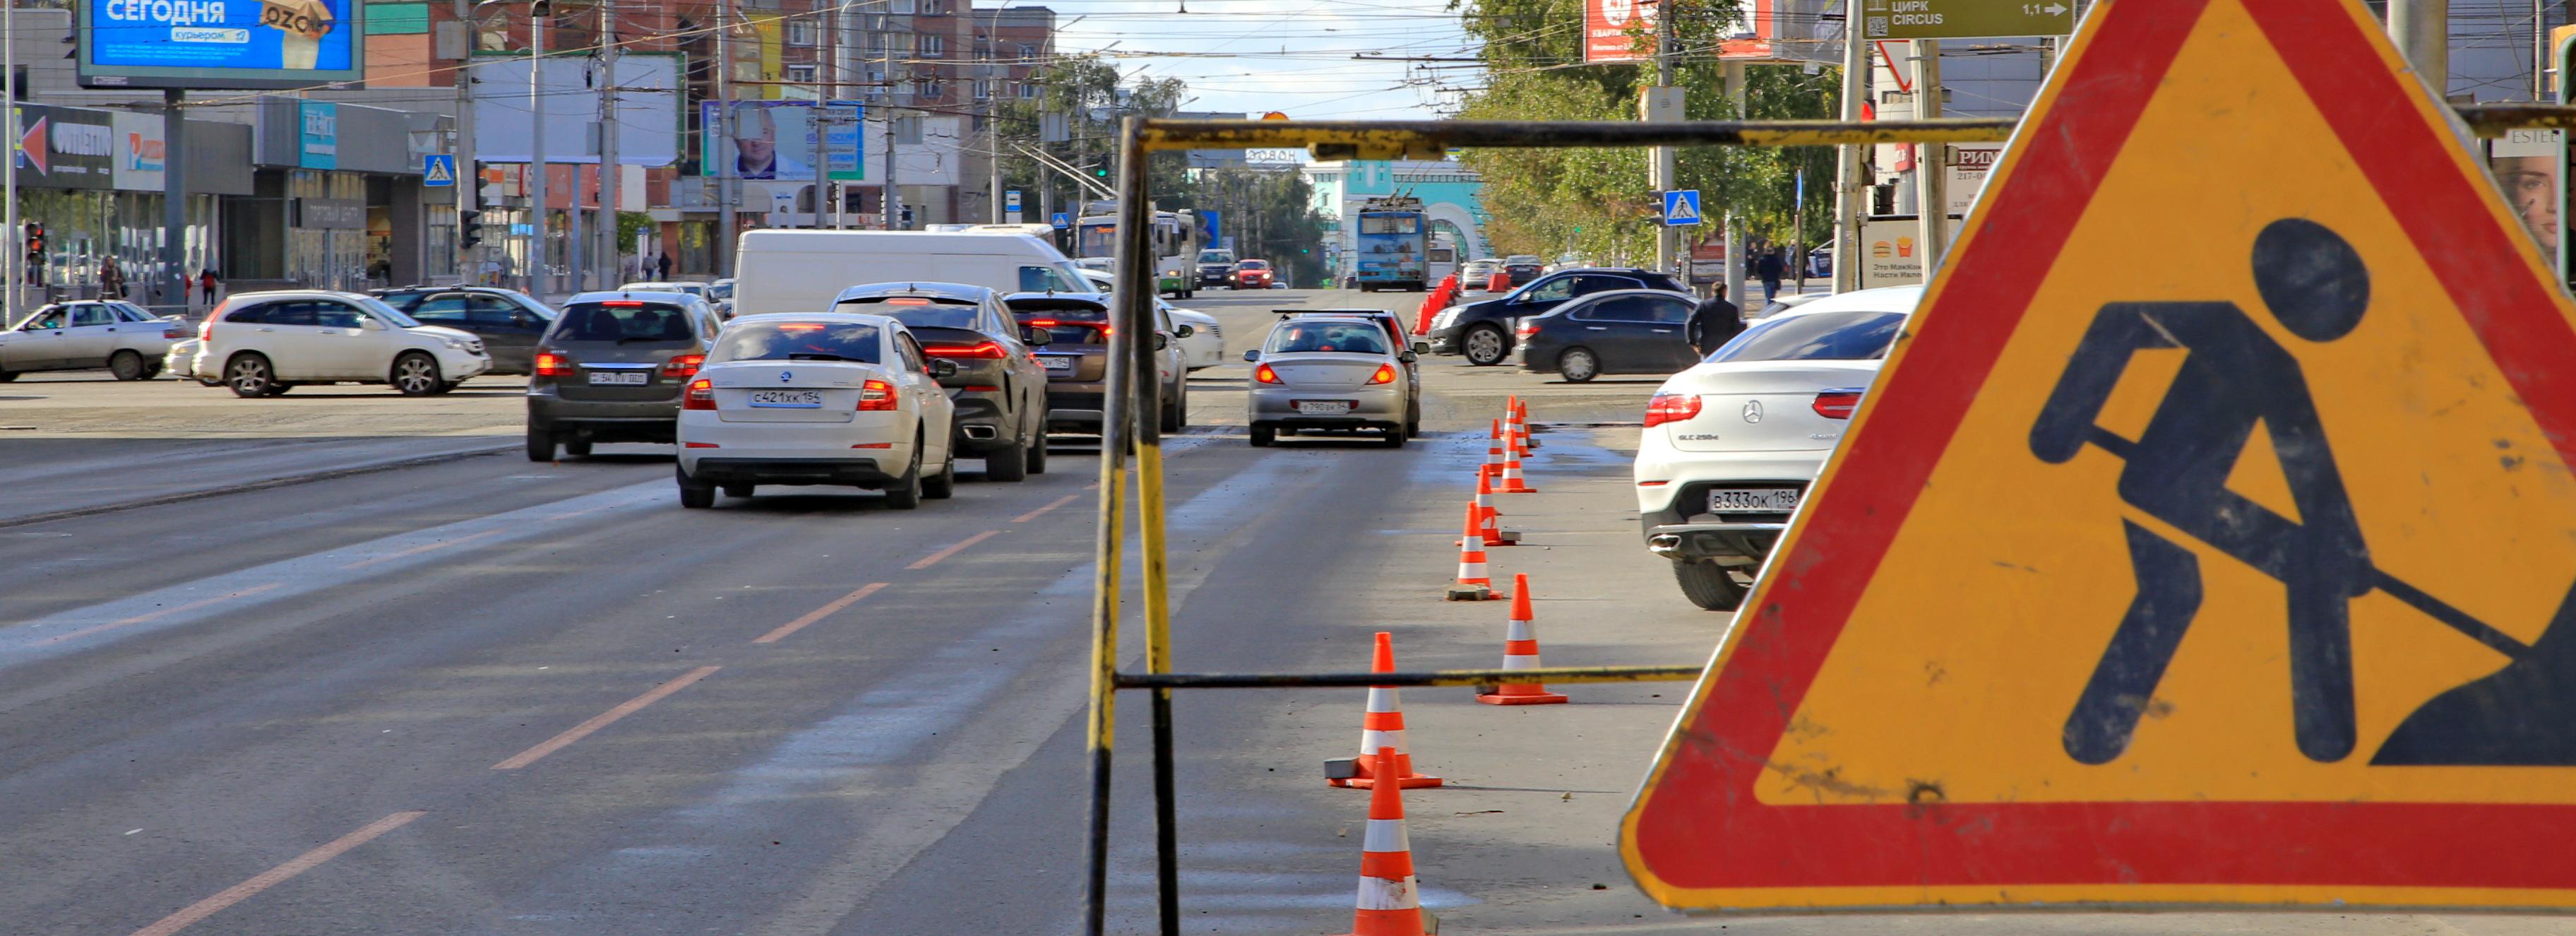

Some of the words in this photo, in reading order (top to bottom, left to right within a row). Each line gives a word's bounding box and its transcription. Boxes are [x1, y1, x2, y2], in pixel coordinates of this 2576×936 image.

[107, 0, 225, 25] СЕГОДНЯ
[1892, 1, 1928, 13] ЦИРК
[2022, 4, 2040, 16] 1,1
[1892, 14, 1943, 25] CIRCUS
[175, 31, 225, 41] курьером
[753, 391, 799, 403] С421ХК
[1714, 492, 1768, 509] В333ОК
[1773, 491, 1794, 503] 196
